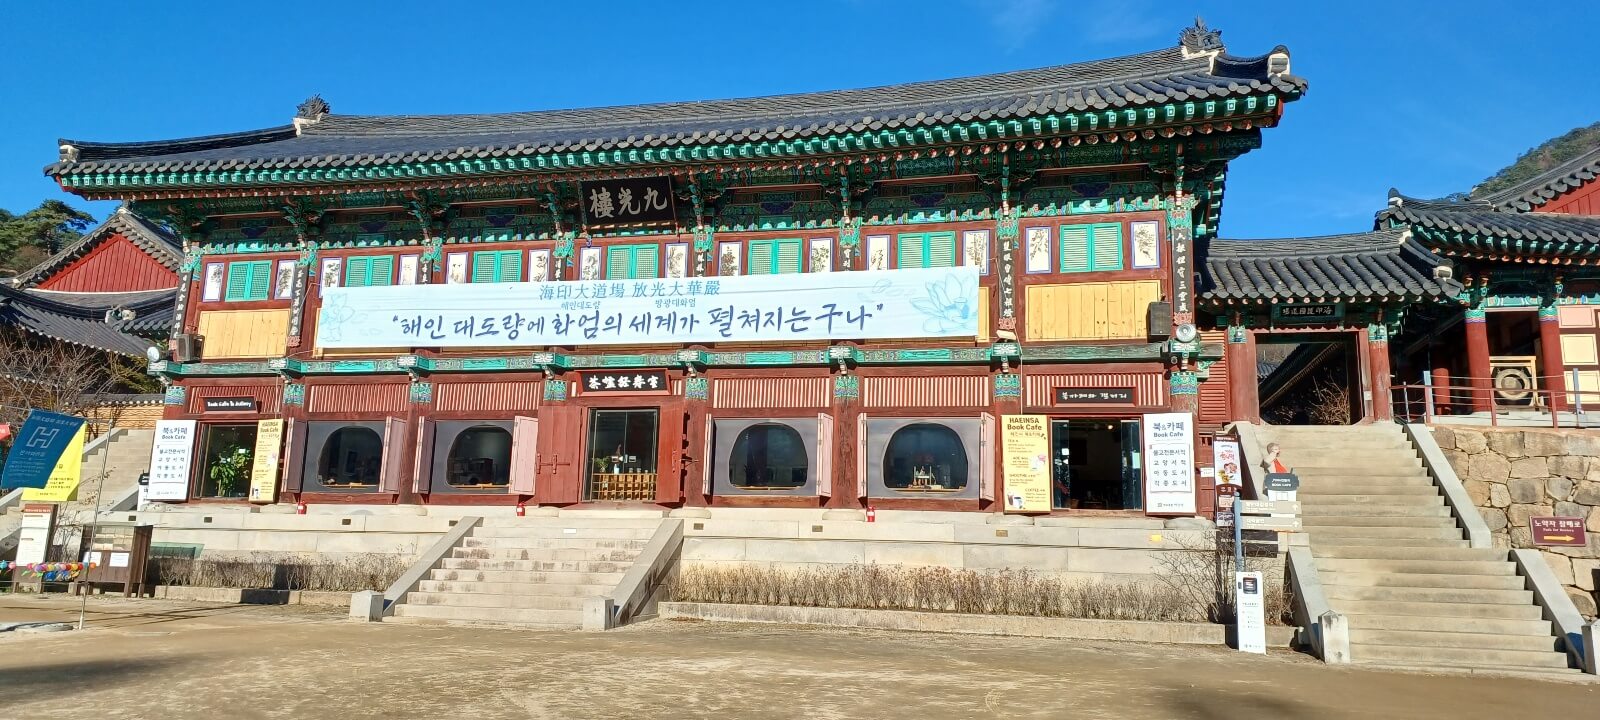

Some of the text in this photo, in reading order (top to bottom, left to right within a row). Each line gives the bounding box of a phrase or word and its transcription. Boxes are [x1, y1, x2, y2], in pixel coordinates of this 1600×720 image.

[539, 280, 721, 299] 海印大道場 放光大華嚴
[561, 298, 696, 310] 해인대도량 방광대화엄
[453, 312, 545, 339] 대도량에
[551, 310, 622, 340] 화엄의
[629, 311, 700, 337] 세계가
